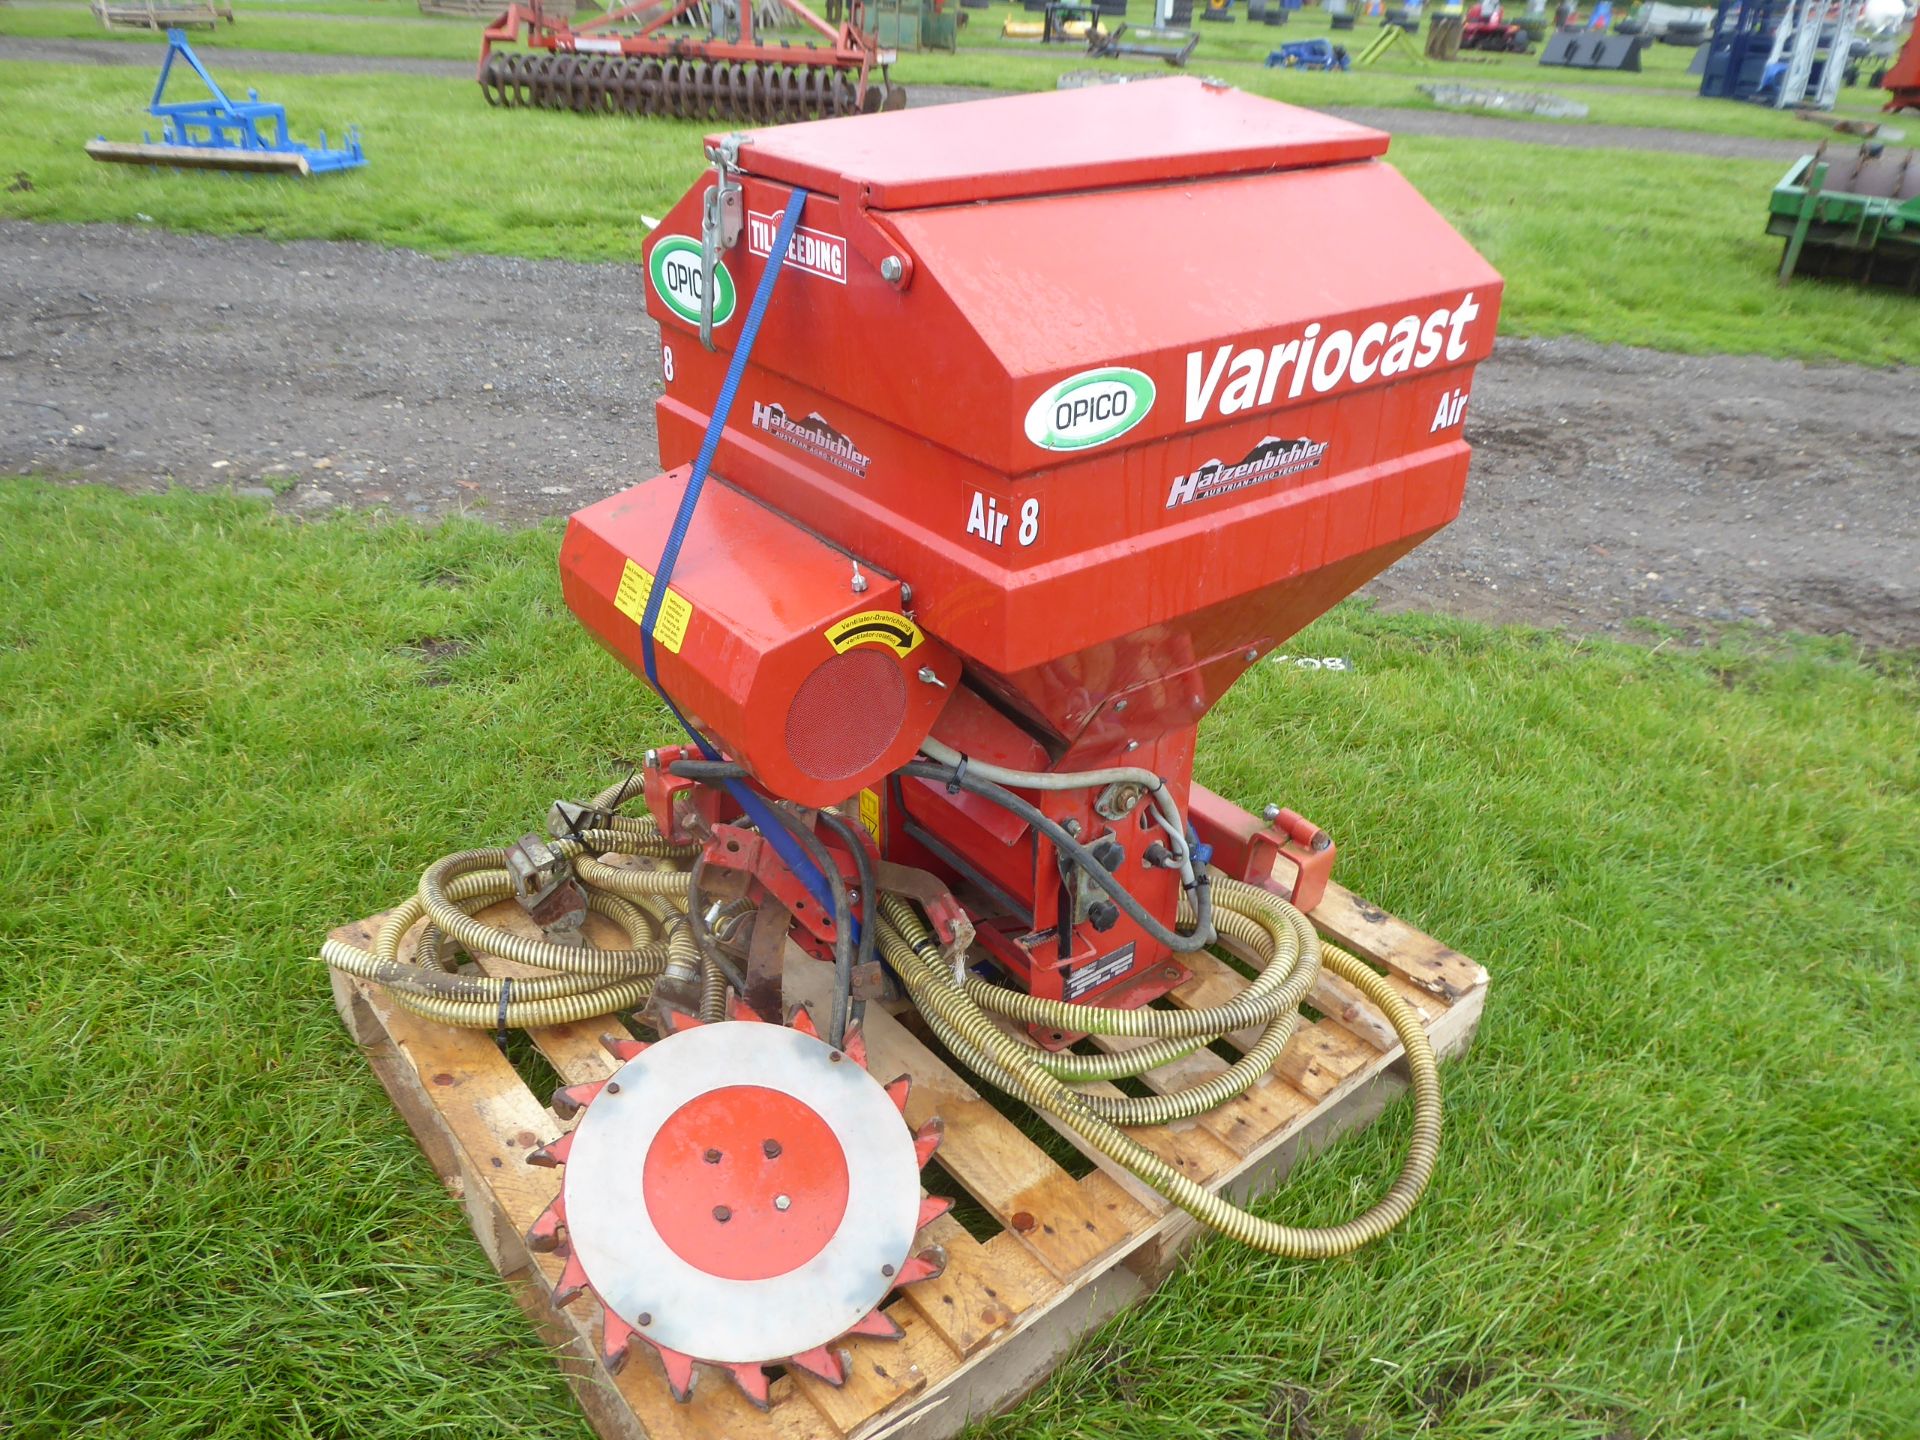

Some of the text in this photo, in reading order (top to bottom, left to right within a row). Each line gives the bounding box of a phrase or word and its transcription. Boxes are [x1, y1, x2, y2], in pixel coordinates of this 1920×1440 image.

[667, 261, 703, 299] OPIC
[664, 345, 674, 382] 8
[1185, 292, 1479, 422] Variocast
[752, 400, 871, 468] Hatzenbichler
[1056, 390, 1128, 430] OPICO
[1430, 388, 1469, 432] Air
[1166, 440, 1328, 509] Hatzenbichler
[966, 491, 1040, 546] Air 8
